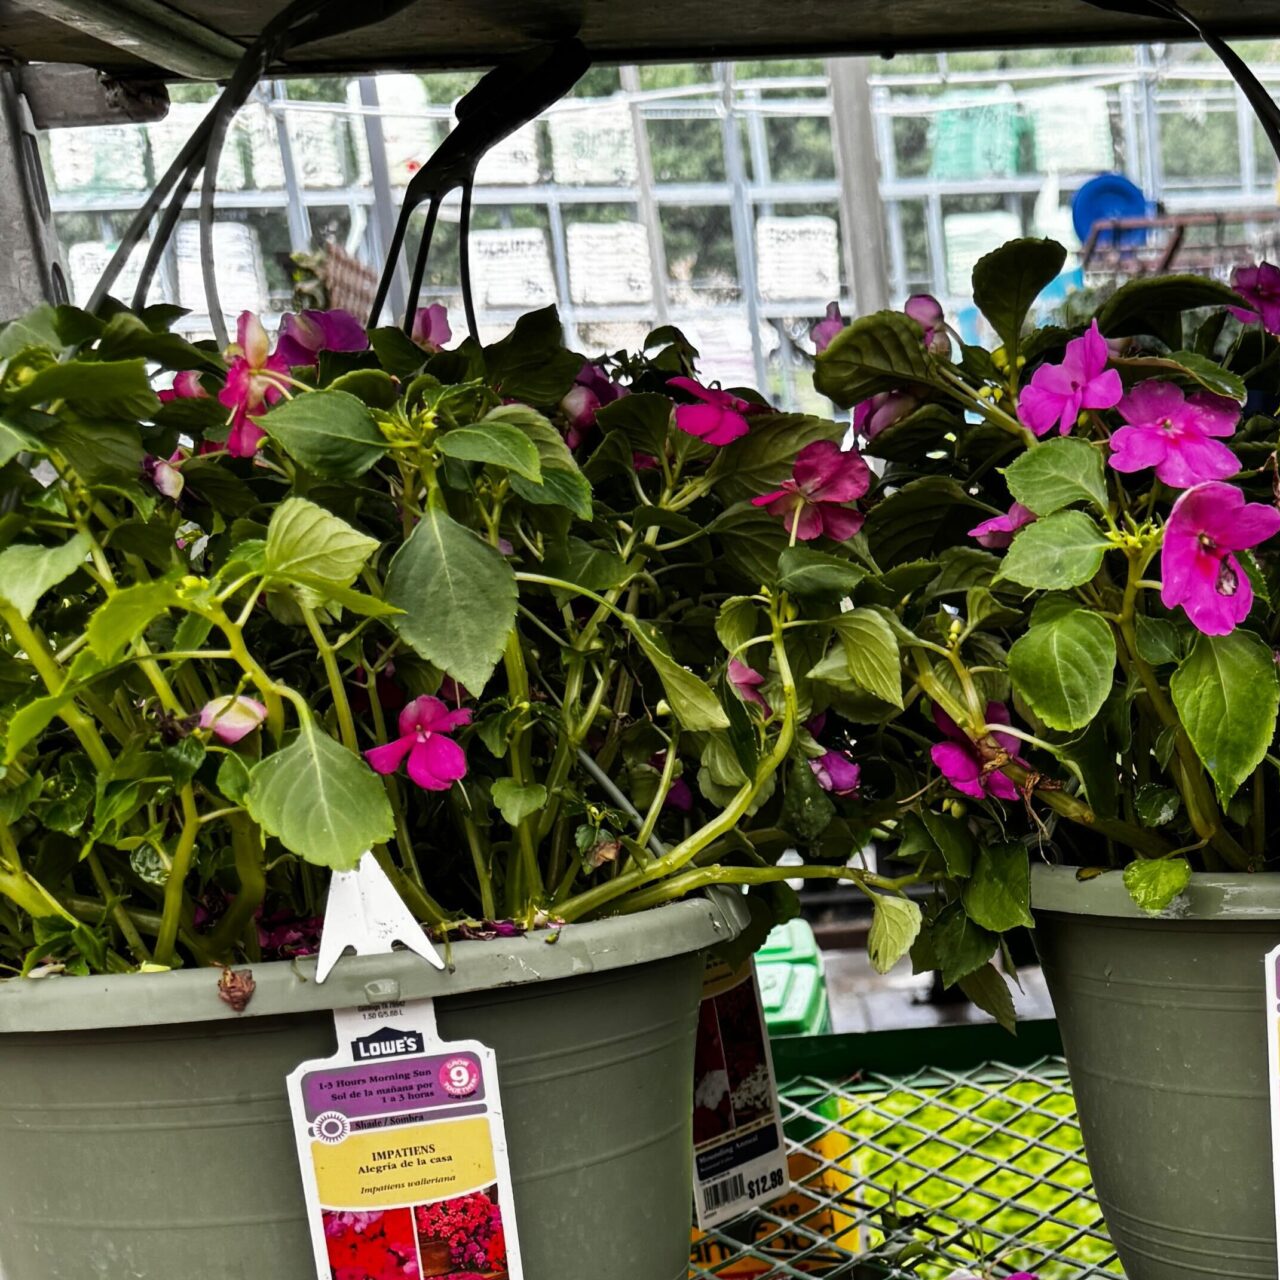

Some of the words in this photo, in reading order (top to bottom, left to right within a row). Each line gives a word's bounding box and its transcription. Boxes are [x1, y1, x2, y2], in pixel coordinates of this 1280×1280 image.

[359, 1036, 417, 1057] LOWE'S
[336, 1078, 366, 1088] Hours
[369, 1072, 410, 1084] Morning
[413, 1069, 431, 1078] Sun
[450, 1066, 470, 1087] 9
[349, 1091, 361, 1099] de
[377, 1085, 414, 1096] mañana
[417, 1082, 433, 1093] por
[408, 1091, 434, 1100] horas
[355, 1119, 382, 1130] Shade
[390, 1114, 424, 1127] Sombra
[372, 1144, 436, 1161] IMPATIENS
[400, 1160, 413, 1168] de
[417, 1158, 427, 1166] la
[430, 1155, 453, 1164] casa
[361, 1182, 405, 1195] Impatiens
[407, 1175, 456, 1188] walleriana
[747, 1168, 784, 1200] $12.98
